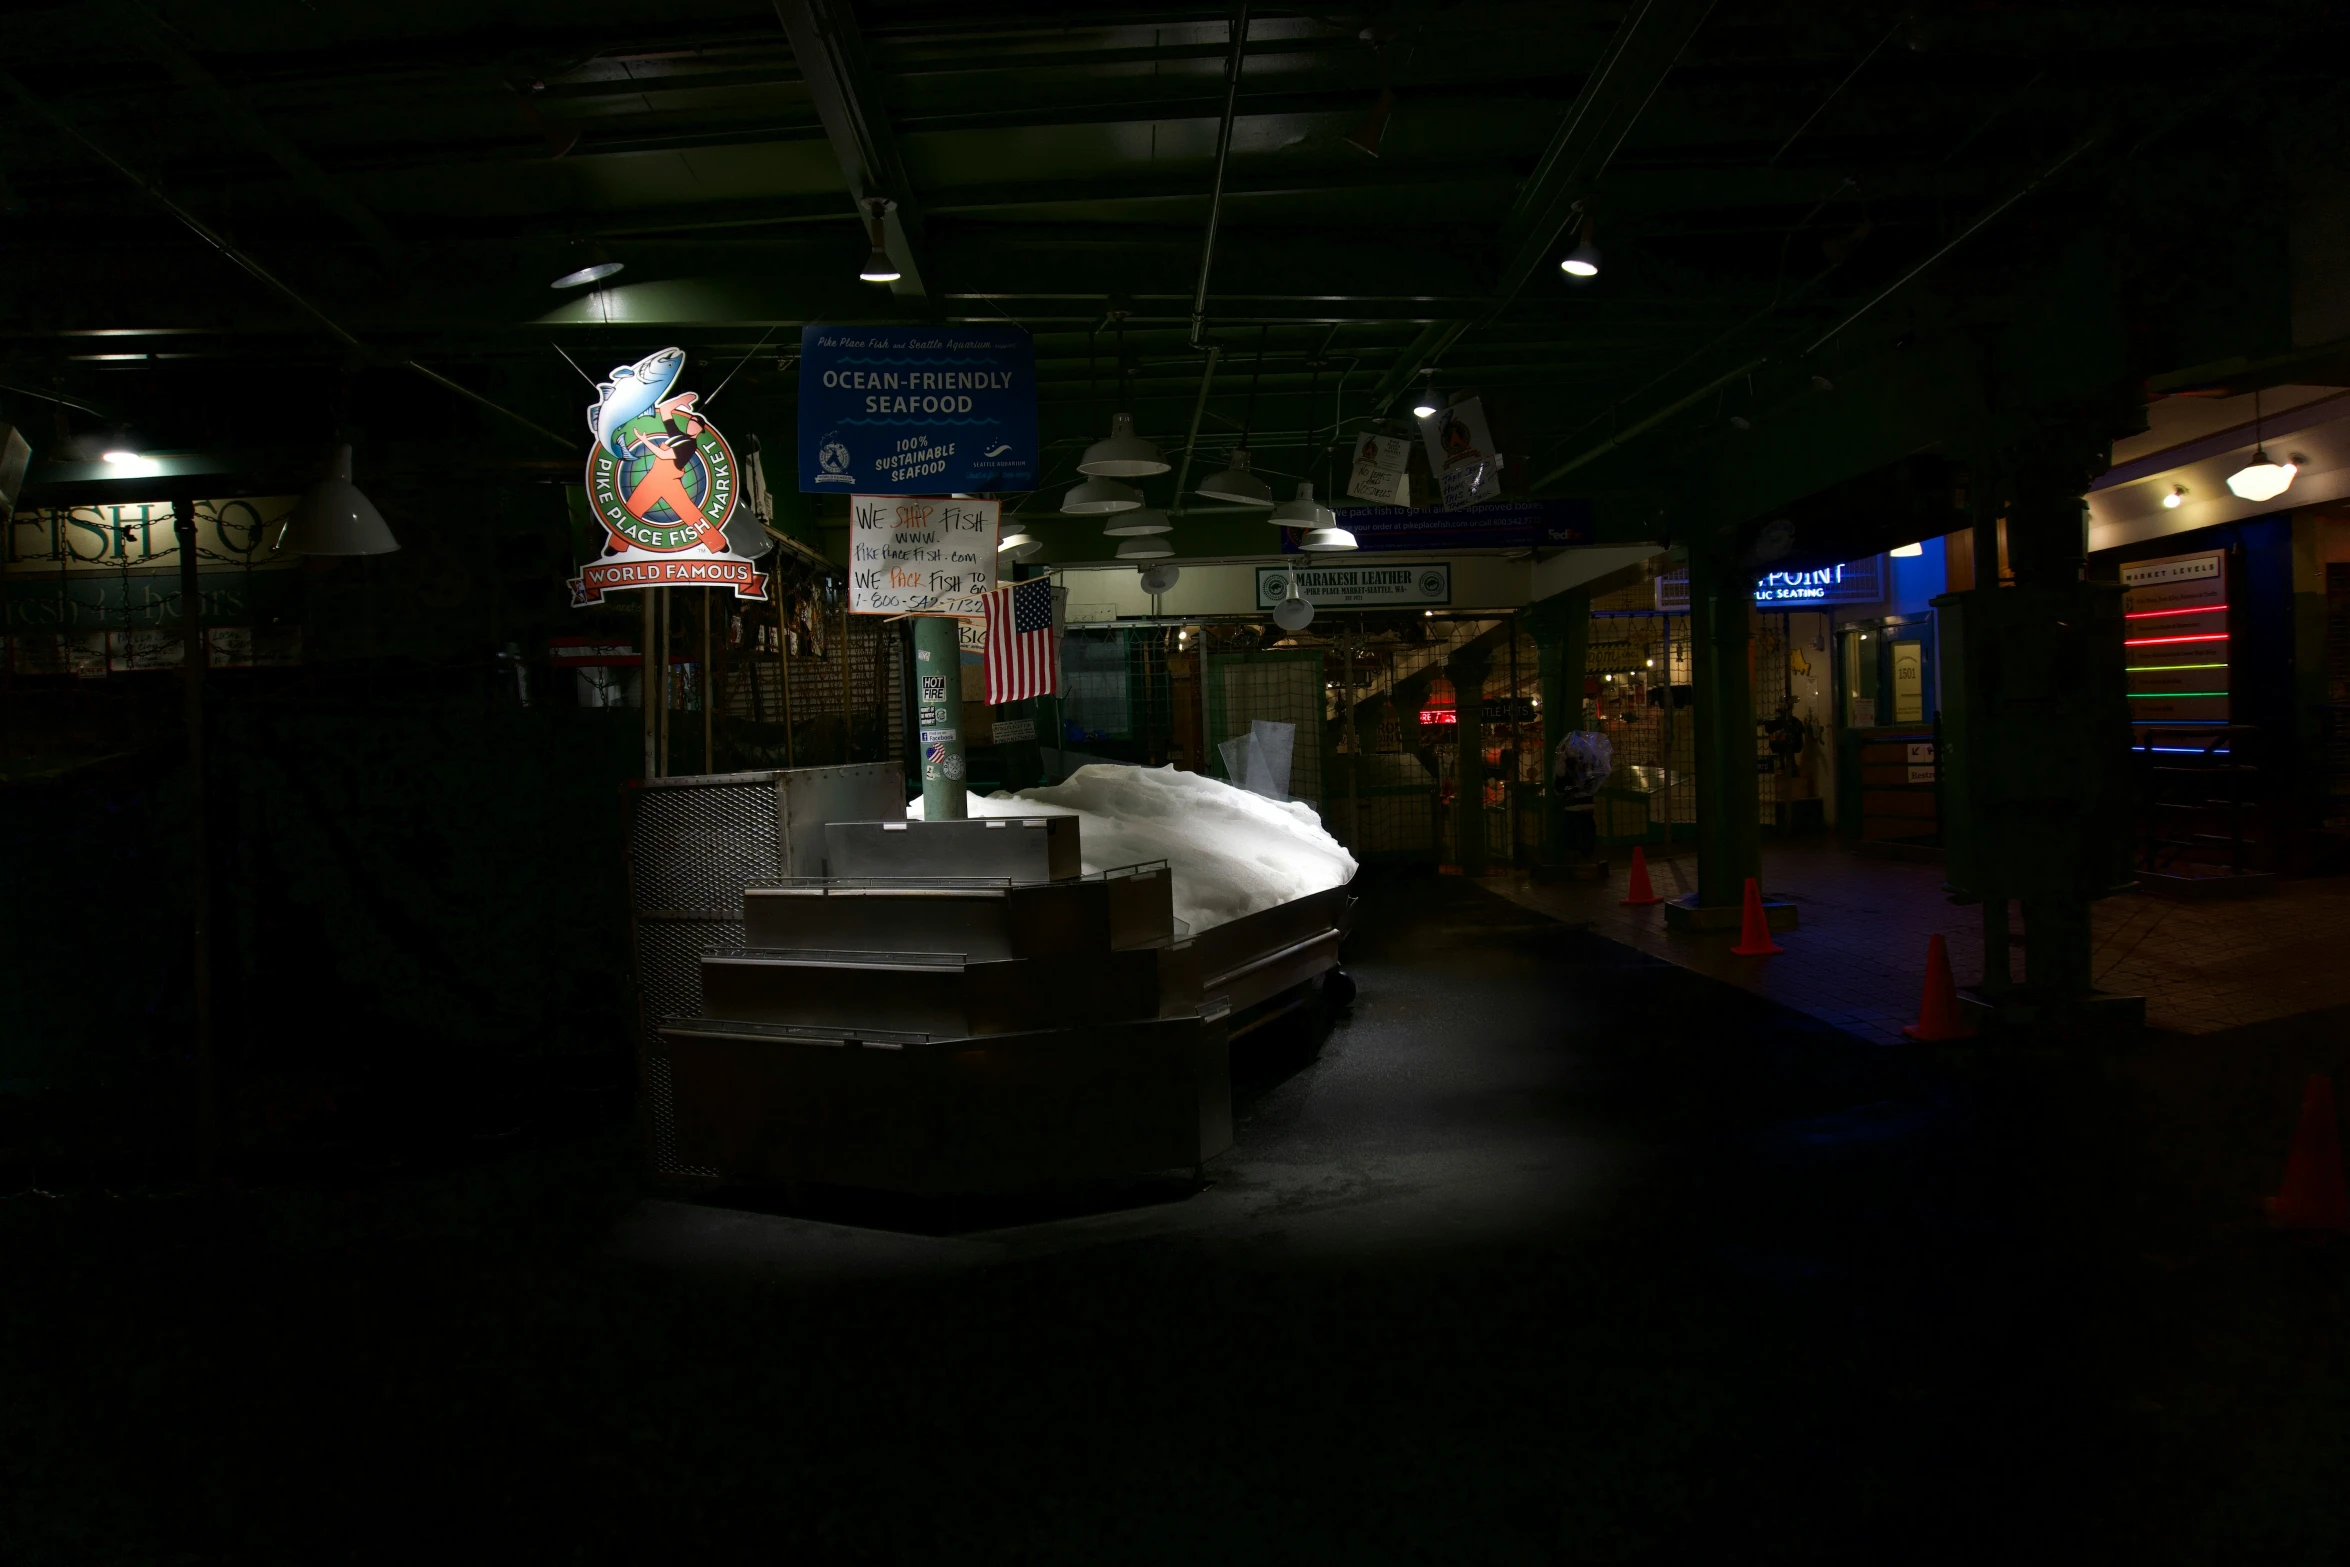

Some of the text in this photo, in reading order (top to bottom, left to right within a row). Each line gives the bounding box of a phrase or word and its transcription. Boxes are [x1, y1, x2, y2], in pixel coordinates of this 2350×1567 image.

[817, 336, 837, 348] Pike
[839, 337, 866, 348] Place
[868, 337, 890, 349] Fish
[908, 339, 943, 349] Seattle
[946, 339, 992, 352] Aquarium
[822, 370, 1013, 390] OCEAN-FRIENDLY
[865, 395, 973, 413] SEAFOOD
[896, 435, 928, 452] 100%
[875, 442, 956, 471] SUSTAINABLE
[891, 460, 946, 482] SEAFOOD
[595, 458, 614, 504] PIKE
[606, 506, 663, 546] PLACE
[669, 518, 711, 546] FISH
[702, 440, 730, 519] MARKET
[856, 502, 888, 529] WE
[1349, 507, 1373, 518] pack
[1374, 506, 1392, 516] fish
[1394, 507, 1405, 515] to
[5, 503, 155, 563] FISH
[1354, 524, 1371, 532] your
[1373, 522, 1392, 531] order
[1403, 519, 1468, 531] pikeplacefish.com
[1479, 519, 1492, 527] call
[1548, 528, 1582, 540] FedEx
[588, 564, 748, 583] WORLD FAMOUS
[855, 566, 986, 592] WE PACK FISH TO
[1296, 570, 1412, 587] MARAKESH LEATHER
[2126, 563, 2215, 581] MARKET LEVELS
[1321, 586, 1340, 596] PLACE
[1776, 587, 1825, 598] SEATING
[924, 677, 944, 688] HOT
[1899, 668, 1916, 680] 1501
[924, 688, 944, 698] FIRE
